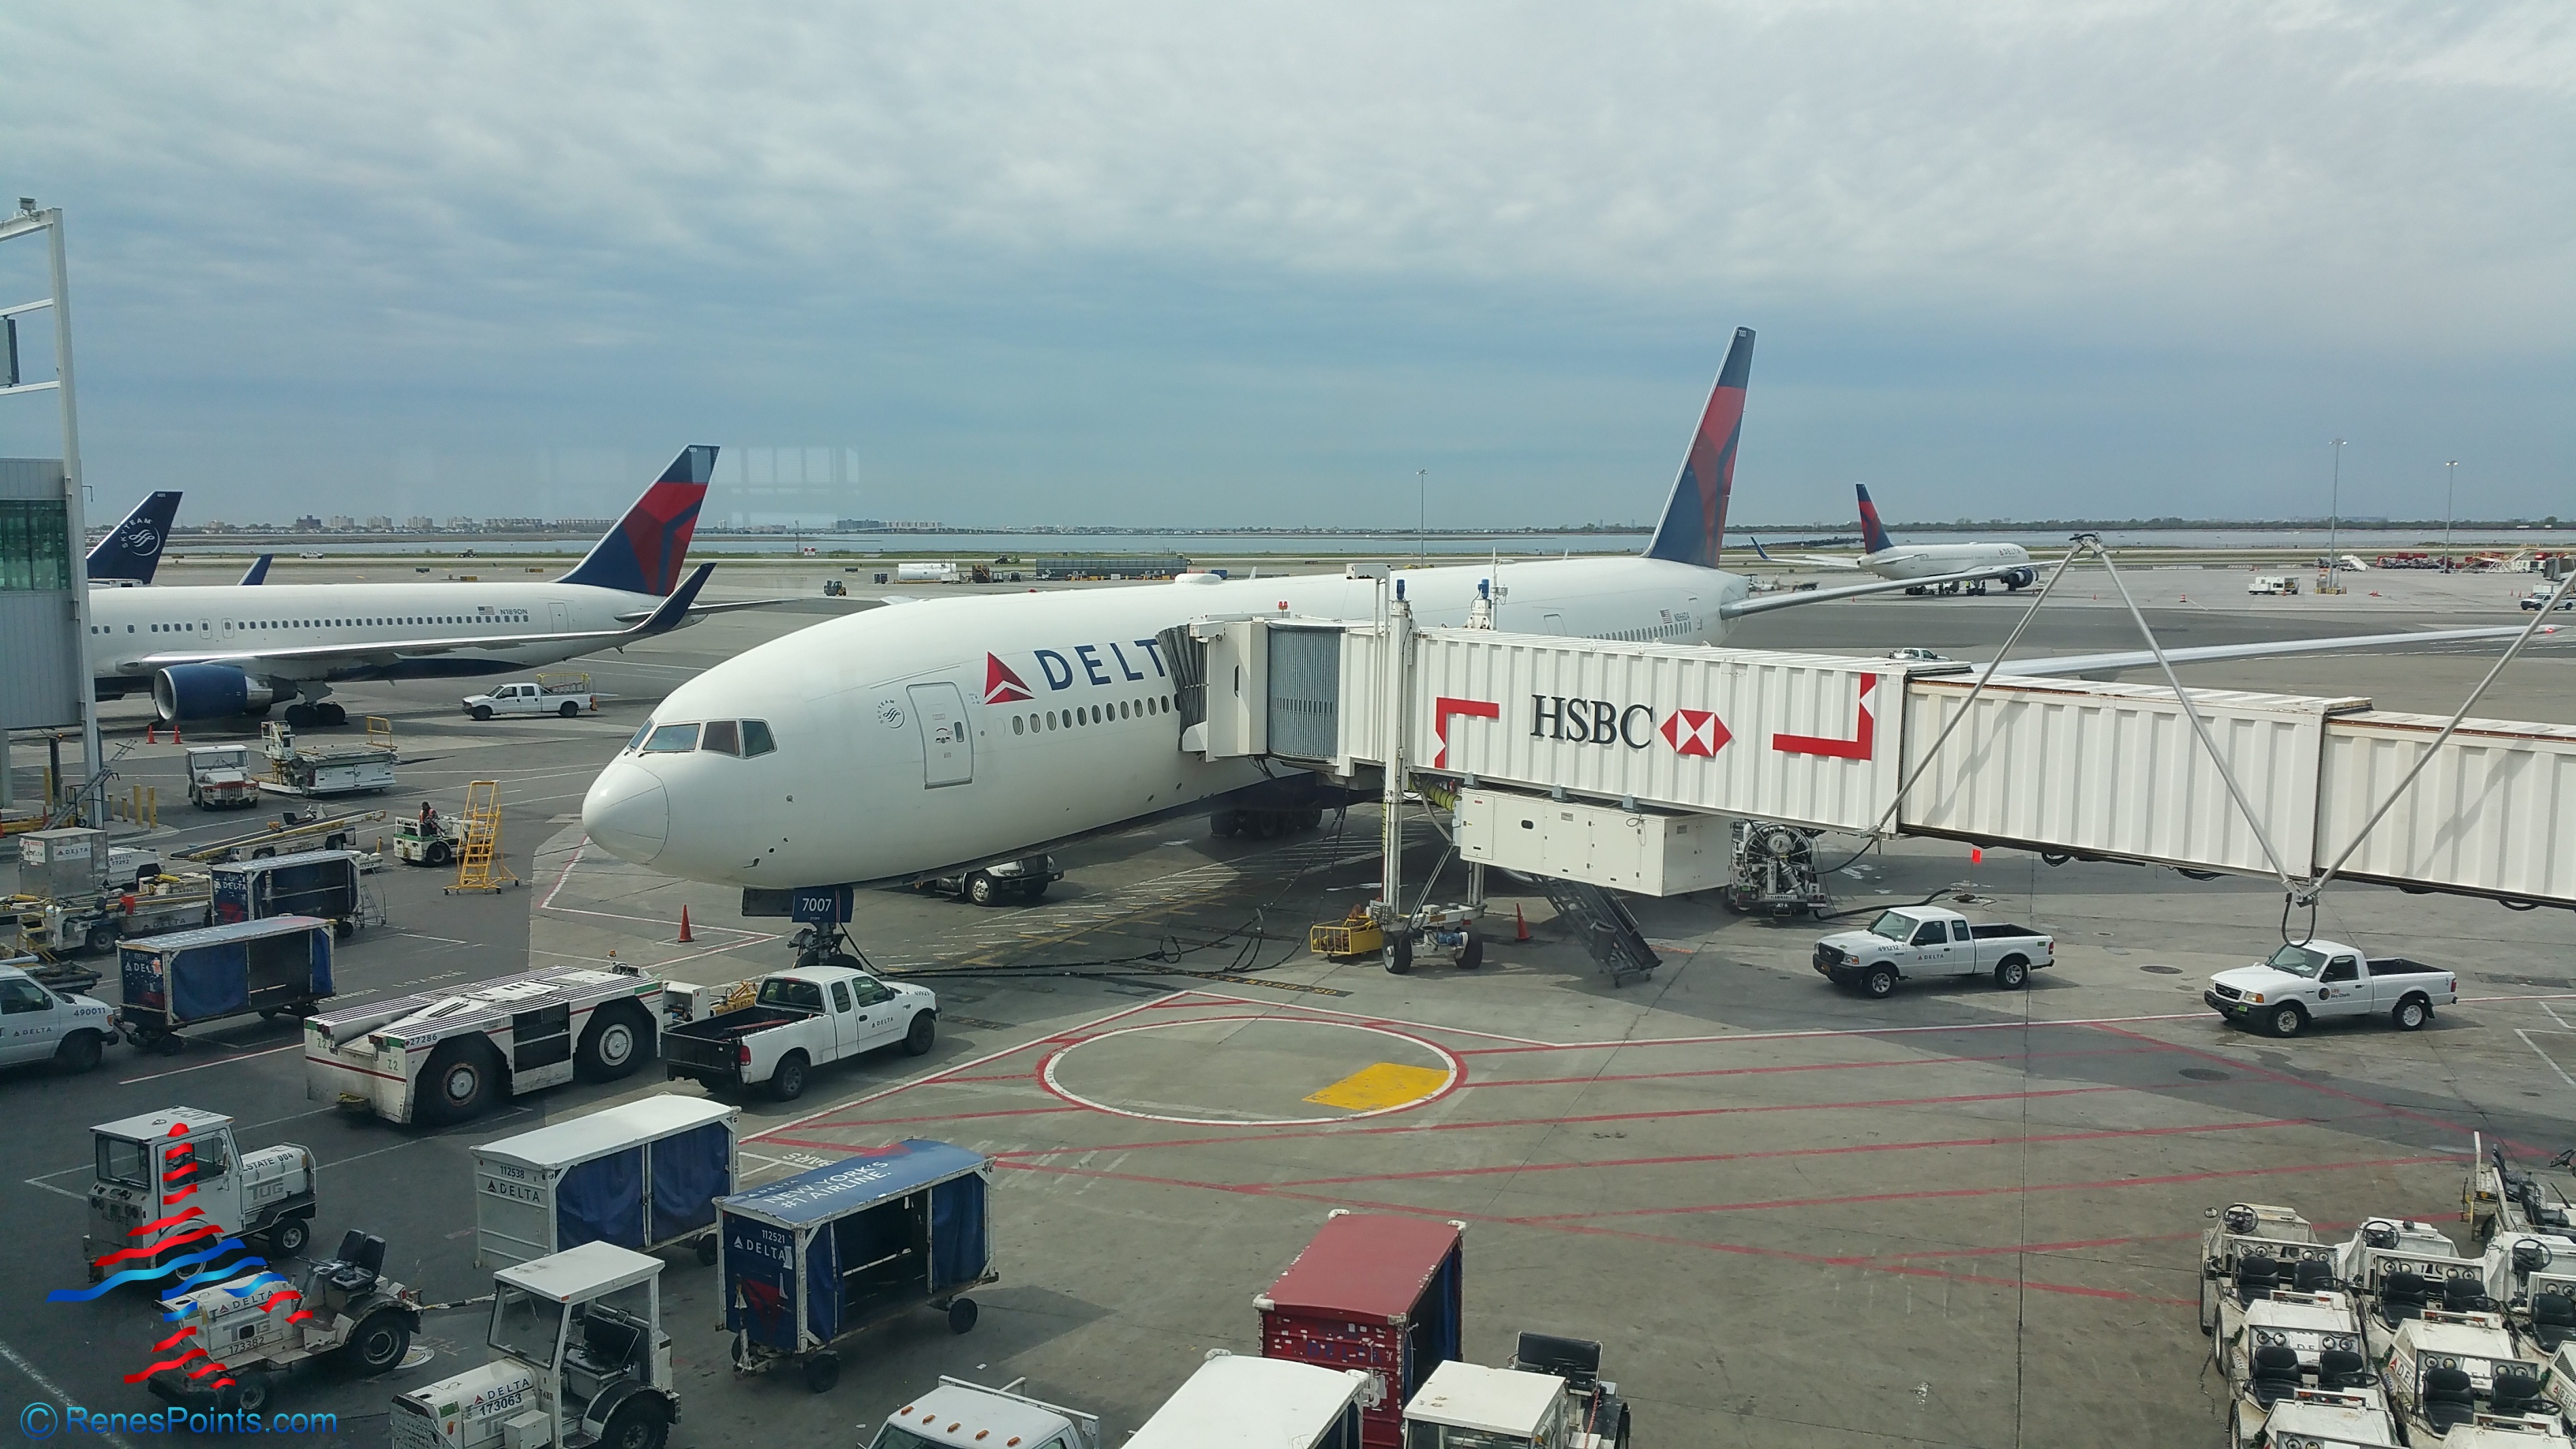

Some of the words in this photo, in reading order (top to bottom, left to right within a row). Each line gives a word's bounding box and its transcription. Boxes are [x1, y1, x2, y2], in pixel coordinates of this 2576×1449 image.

[121, 518, 152, 549] SKYTEAM
[1033, 638, 1166, 691] DELT
[878, 699, 895, 724] SKYTEAM
[1530, 695, 1653, 749] HSBC
[223, 882, 247, 891] DELTA
[802, 898, 832, 912] 7007
[73, 1007, 106, 1017] 490011
[877, 1017, 894, 1027] DELTA
[410, 1034, 437, 1046] 27286
[242, 1156, 275, 1172] LSTATE
[500, 1166, 525, 1179] 112538
[245, 1178, 284, 1201] TUG
[500, 1183, 540, 1202] DELTA
[762, 1183, 815, 1204] NEW
[814, 1162, 889, 1185] YORK'S
[781, 1196, 808, 1208] #1
[811, 1171, 892, 1200] AIRLINE.
[762, 1230, 785, 1244] 112521
[747, 1239, 787, 1261] DELTA
[233, 1290, 275, 1309] DELTA
[229, 1337, 264, 1355] 173382
[2397, 1363, 2416, 1389] DEL
[487, 1378, 531, 1400] DELTA
[2559, 1389, 2576, 1410] DELT
[479, 1393, 522, 1417] 173063
